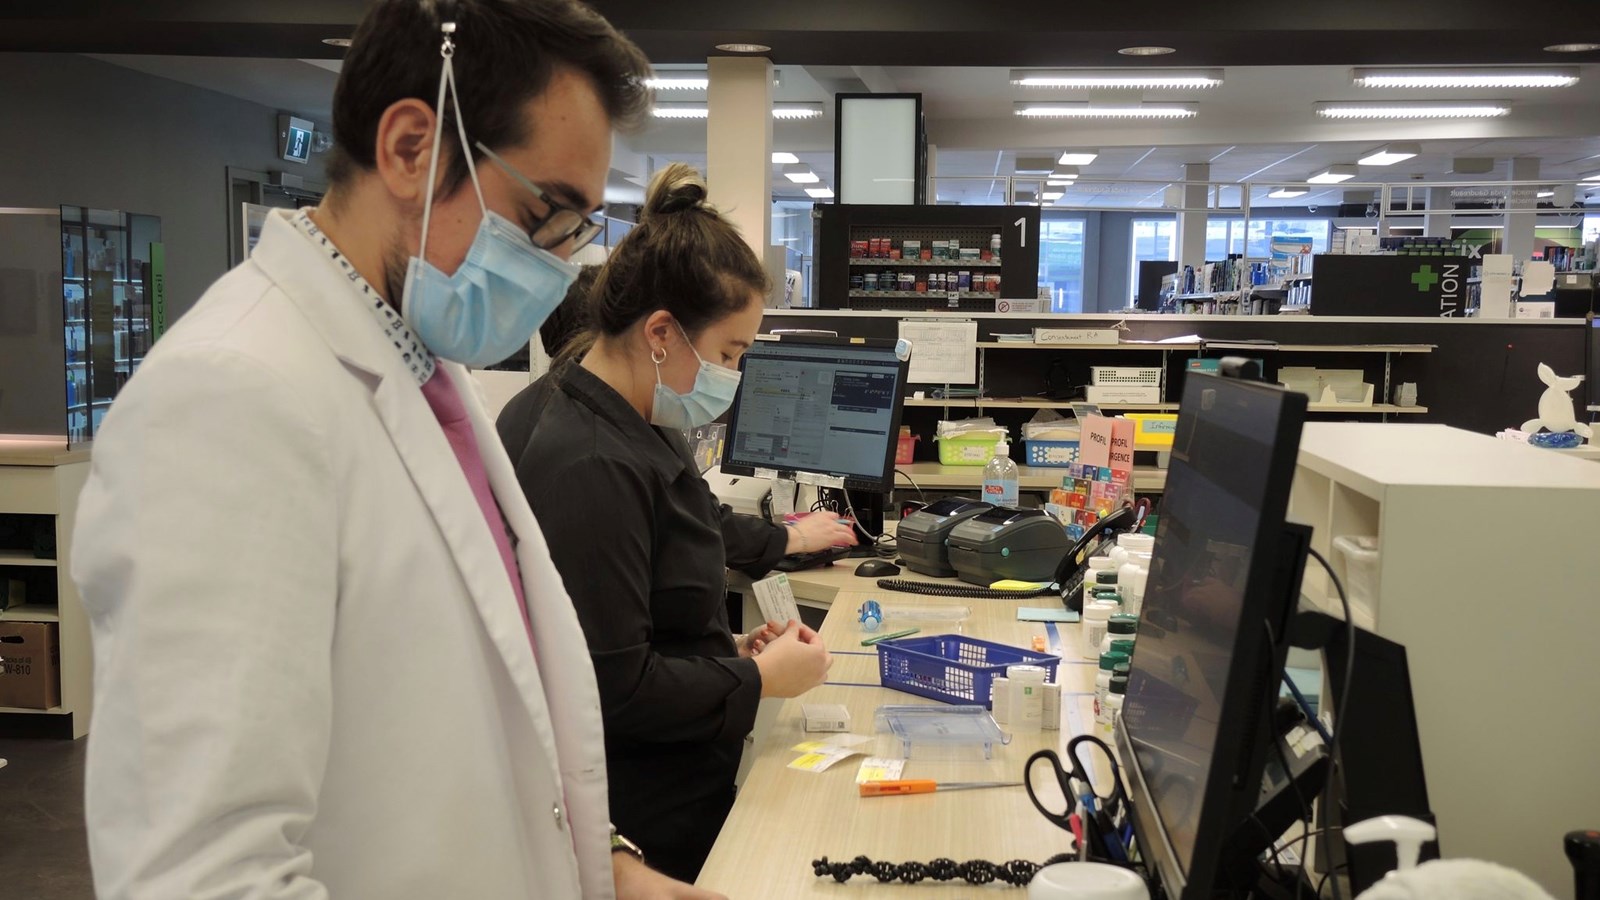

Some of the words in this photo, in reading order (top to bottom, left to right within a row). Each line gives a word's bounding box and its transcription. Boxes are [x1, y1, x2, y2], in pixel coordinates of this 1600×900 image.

[1013, 216, 1026, 248] 1
[1440, 264, 1460, 317] ATION
[1090, 431, 1107, 446] PROFIL
[1110, 437, 1128, 448] PROFIL
